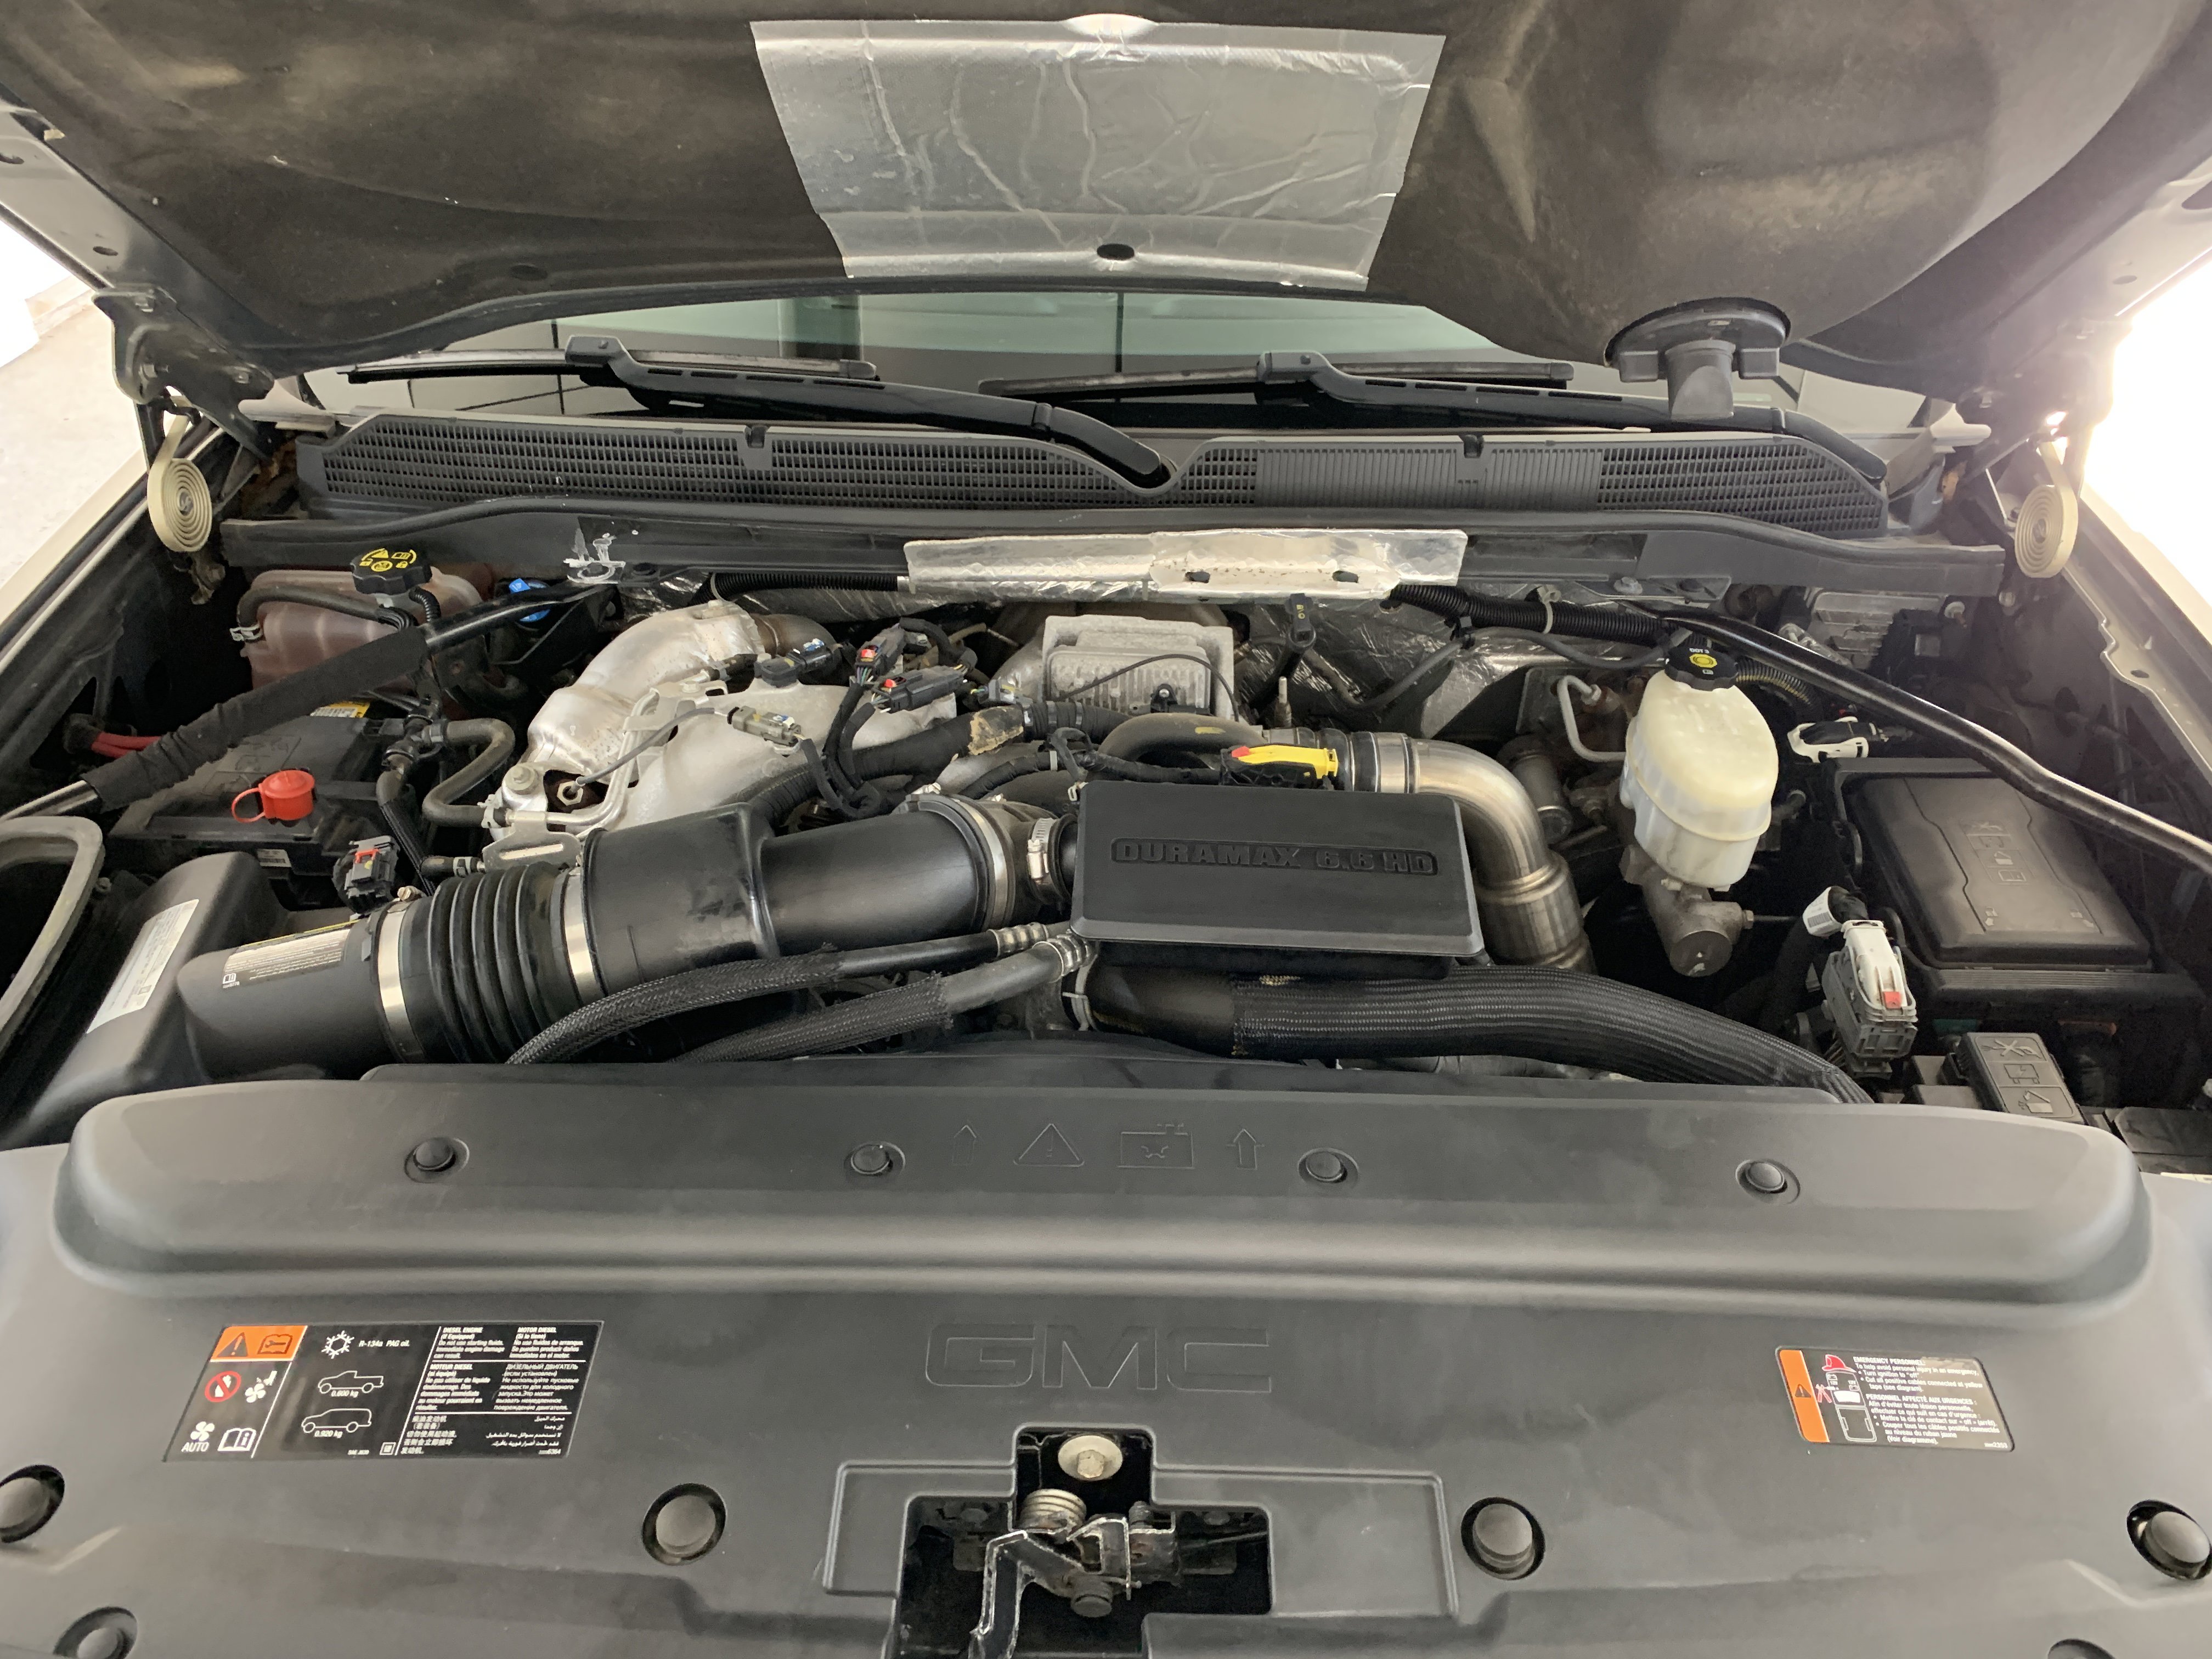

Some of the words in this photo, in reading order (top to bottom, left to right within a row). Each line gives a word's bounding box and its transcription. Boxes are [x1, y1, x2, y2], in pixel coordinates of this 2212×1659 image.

[1116, 840, 1301, 868] DURAMAX
[1317, 850, 1375, 871] 6.6
[1383, 850, 1434, 874] HD
[925, 1323, 1272, 1393] GMC
[334, 1430, 343, 1438] kg
[181, 1442, 210, 1452] AUTO
